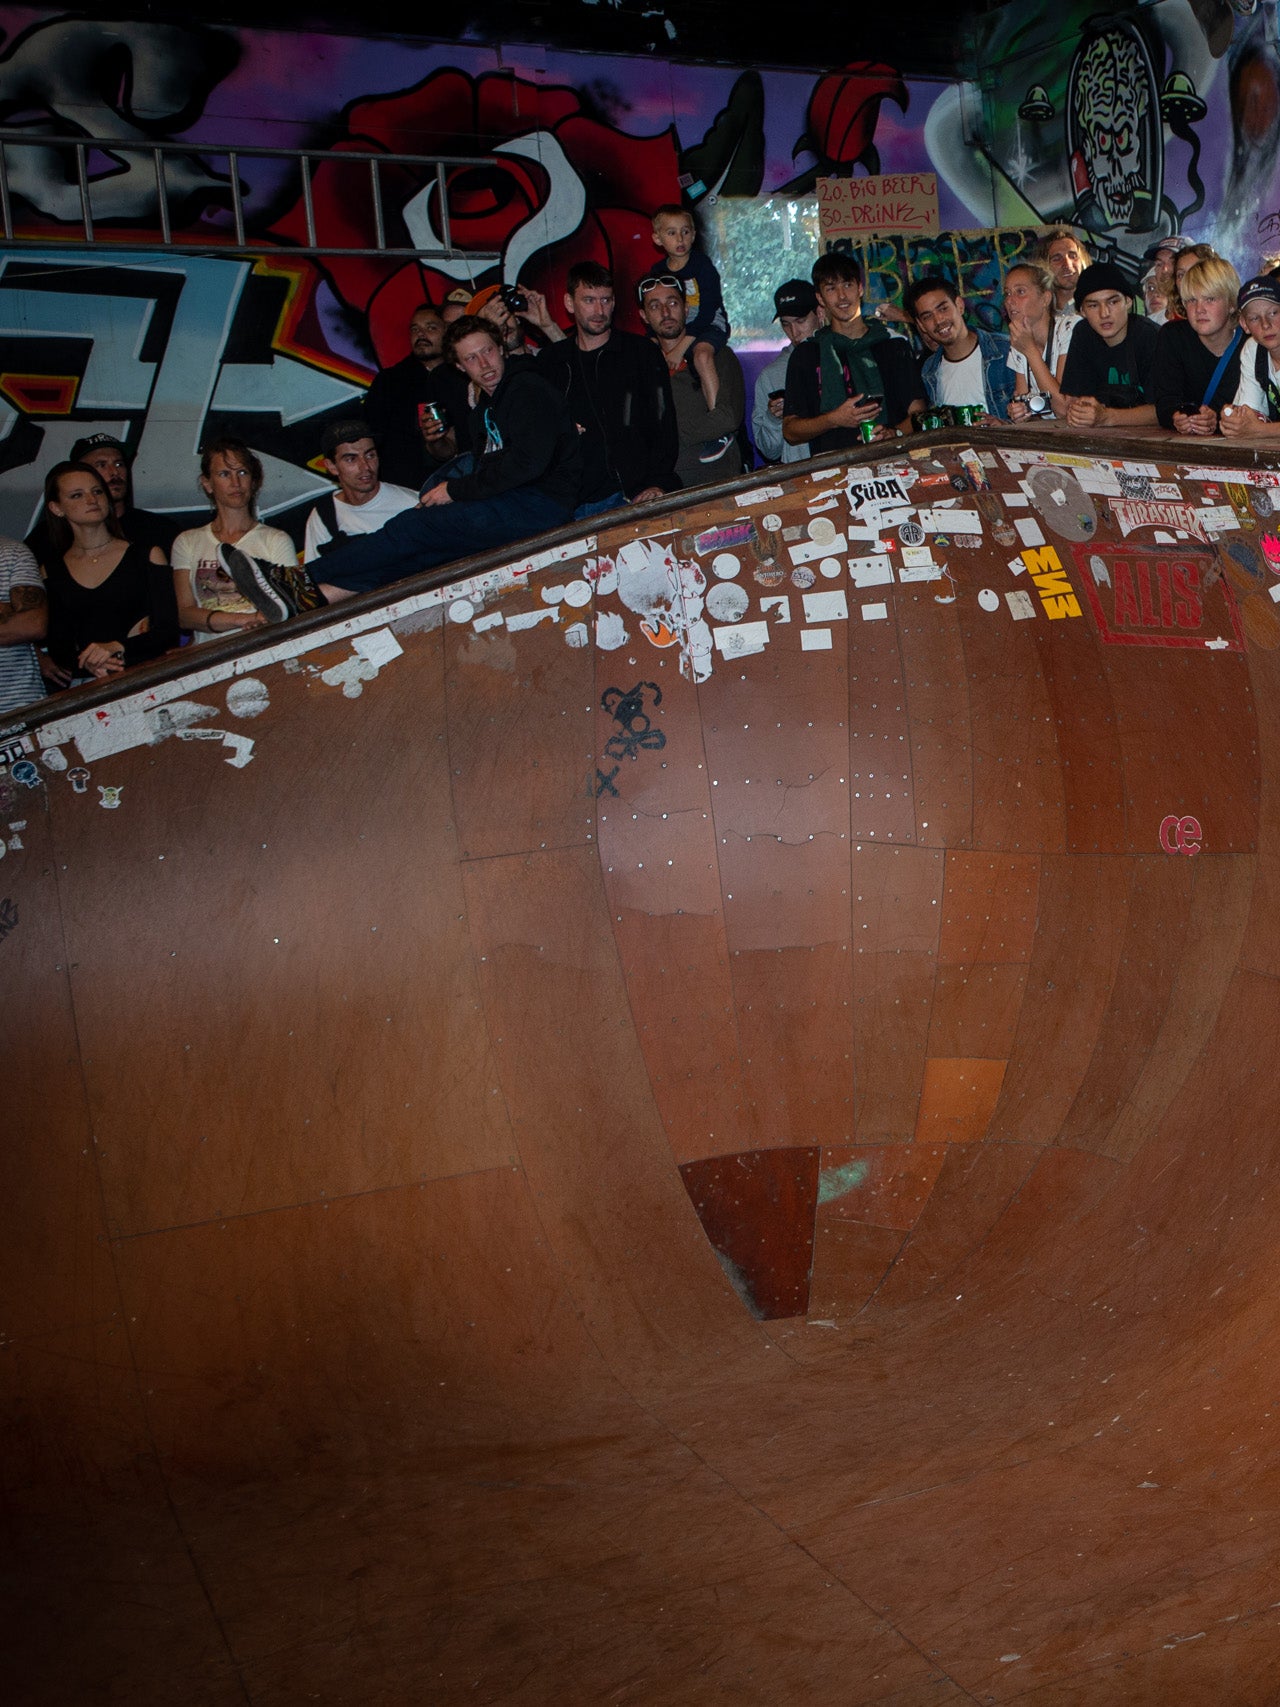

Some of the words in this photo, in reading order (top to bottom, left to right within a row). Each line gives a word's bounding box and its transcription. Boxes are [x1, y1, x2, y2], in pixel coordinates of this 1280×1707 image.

[882, 176, 936, 195] BEER
[1109, 500, 1207, 541] THRASHER
[1114, 561, 1202, 629] ALIS
